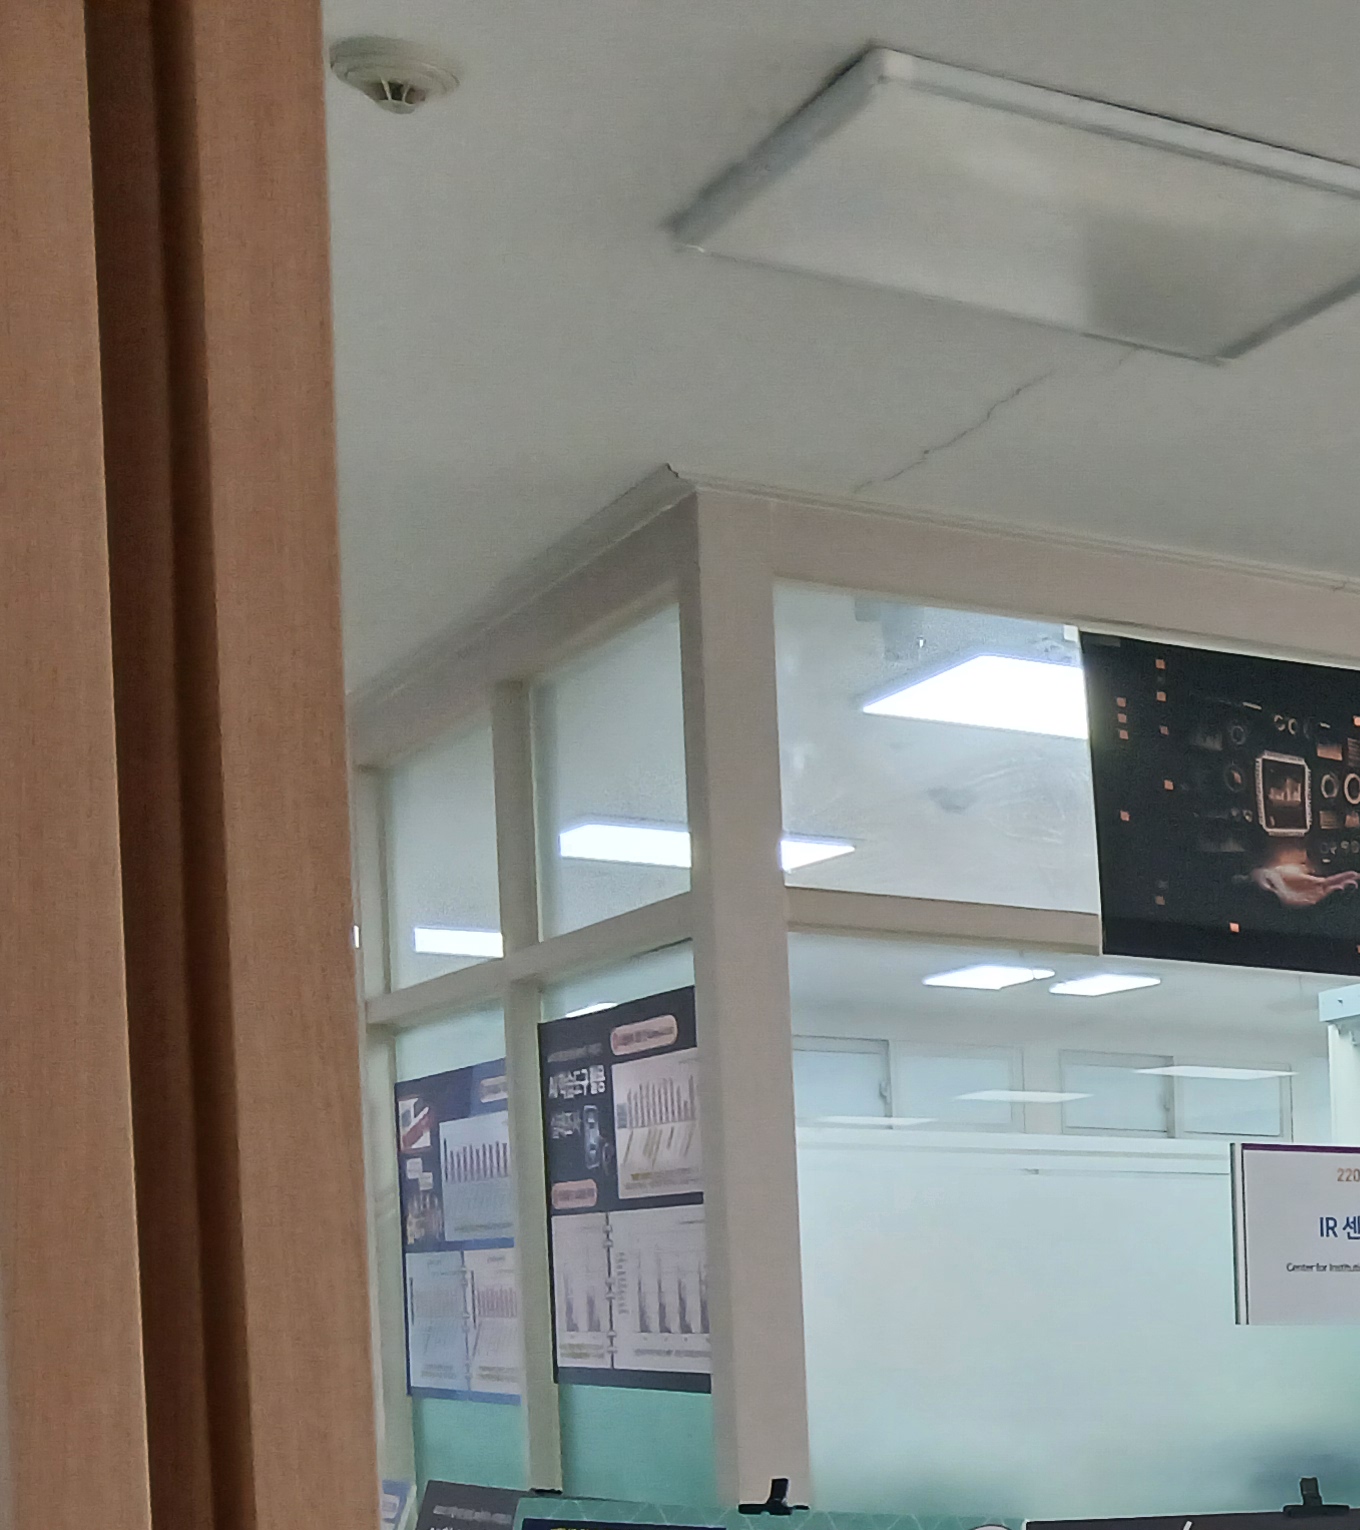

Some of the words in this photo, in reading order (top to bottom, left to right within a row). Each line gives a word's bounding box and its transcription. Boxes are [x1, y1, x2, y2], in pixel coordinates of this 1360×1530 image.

[1337, 1168, 1360, 1182] 220
[1319, 1216, 1339, 1238] IR
[1286, 1262, 1314, 1273] Center
[1316, 1262, 1327, 1272] for
